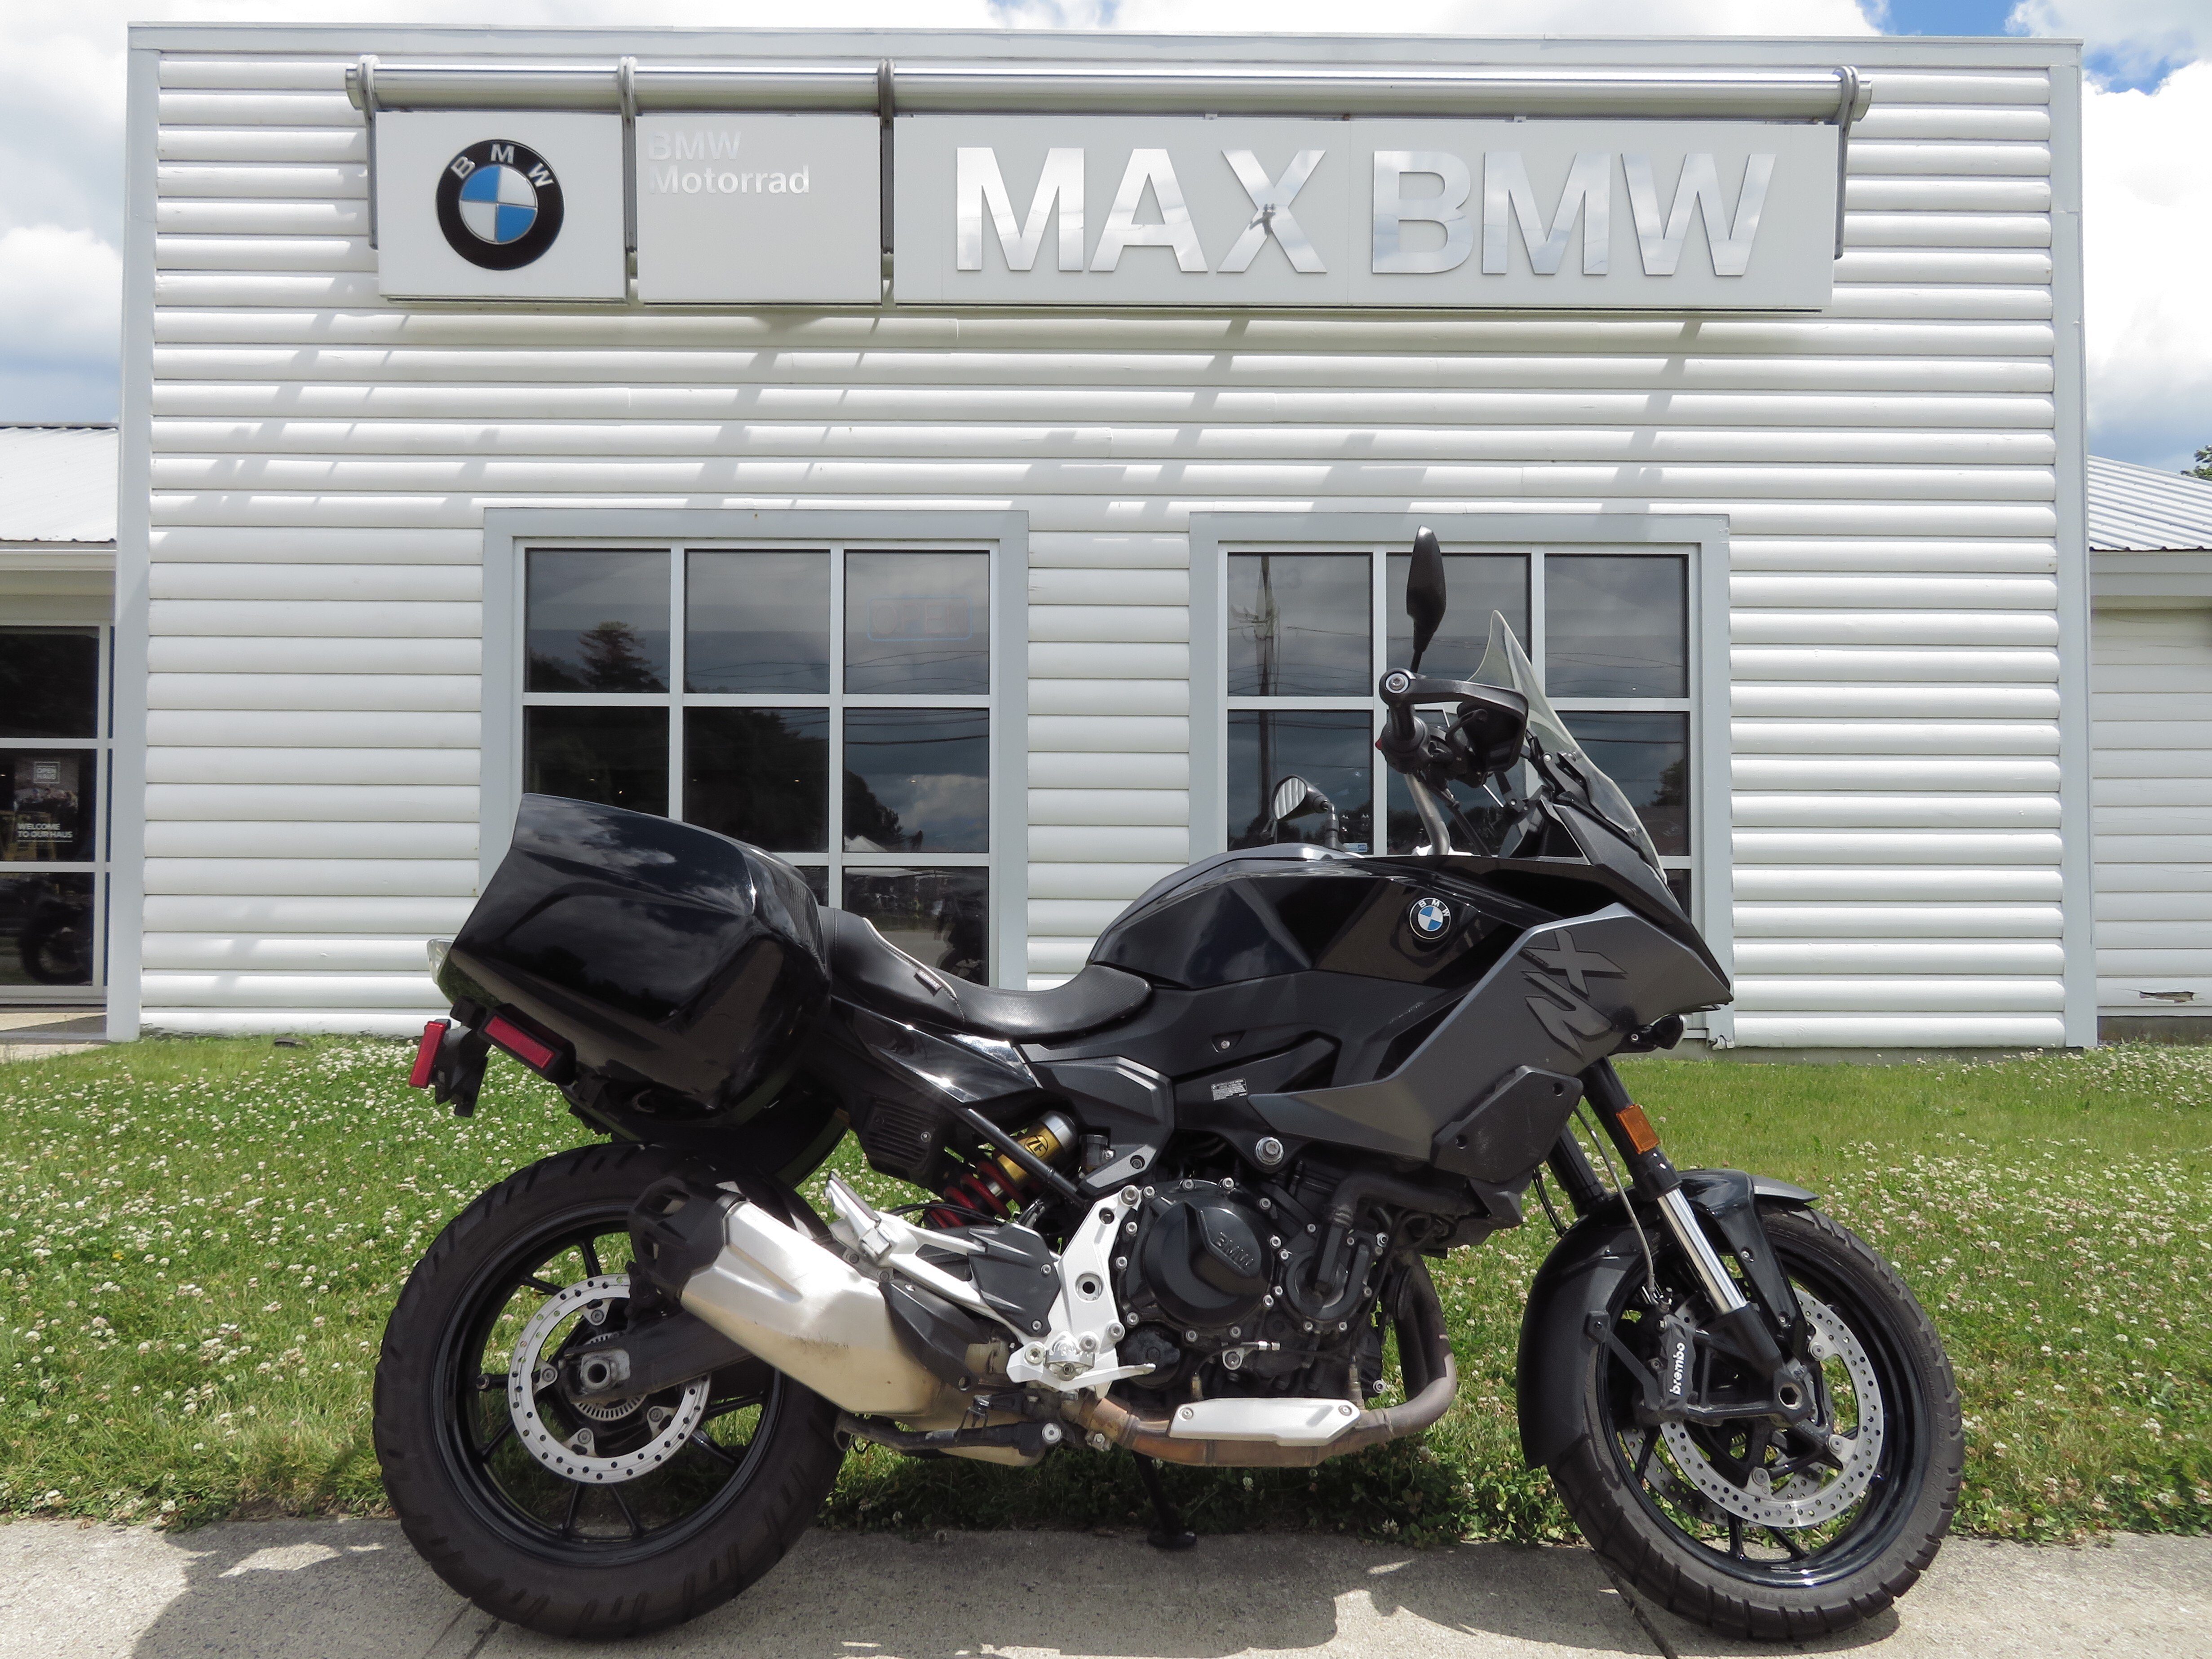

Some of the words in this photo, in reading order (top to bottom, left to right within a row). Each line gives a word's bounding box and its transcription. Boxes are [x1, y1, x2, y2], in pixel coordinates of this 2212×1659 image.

[648, 131, 742, 160] BMW
[451, 144, 554, 187] BMW
[649, 164, 809, 194] Motorrad
[956, 146, 1327, 274] MAX
[1371, 150, 1776, 277] BMW
[872, 602, 969, 635] OPEN
[1418, 899, 1450, 917] BMW
[1214, 1231, 1254, 1270] BMW
[1669, 1342, 1686, 1396] brembo
